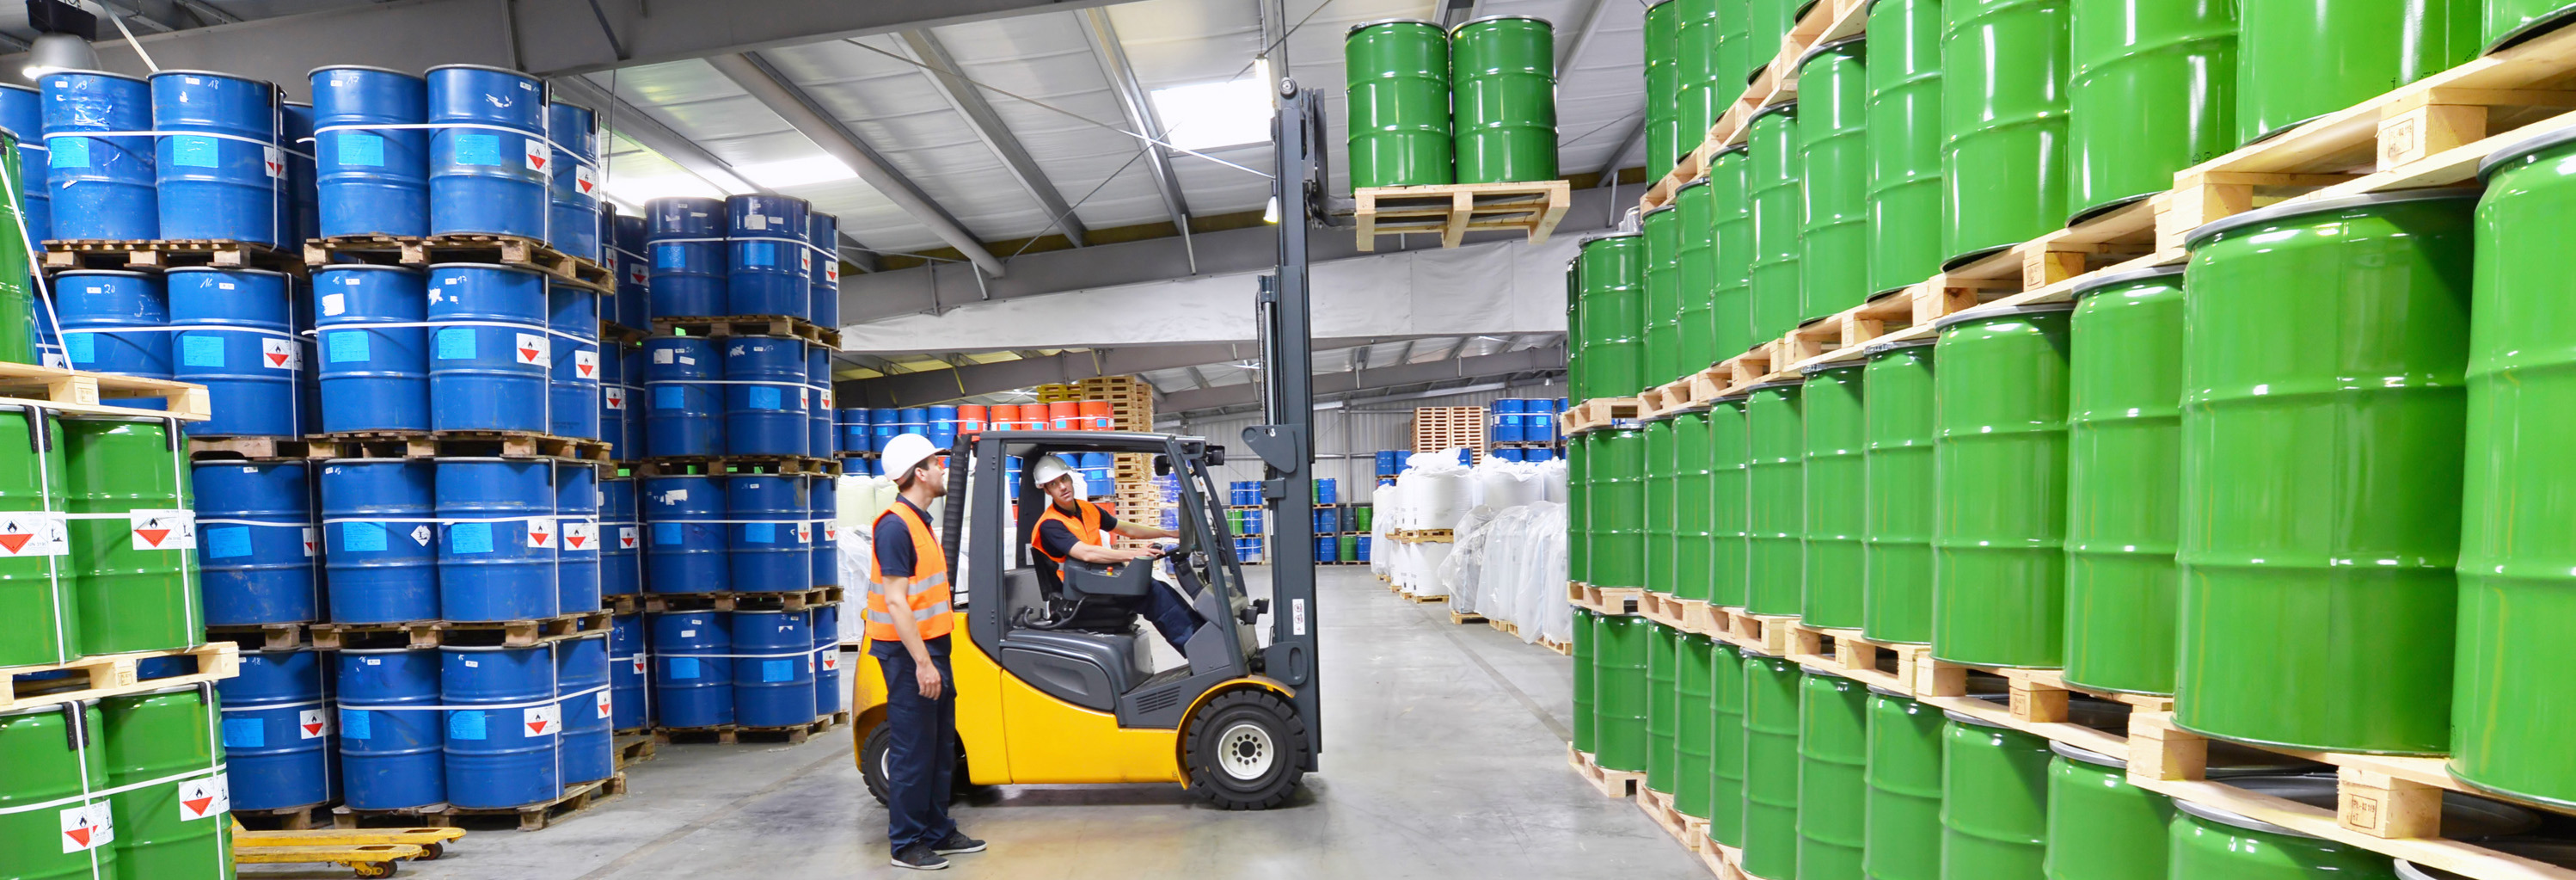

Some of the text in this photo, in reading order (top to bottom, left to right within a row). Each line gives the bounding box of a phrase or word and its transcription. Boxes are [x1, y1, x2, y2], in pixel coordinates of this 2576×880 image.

[75, 80, 88, 90] 19
[207, 79, 219, 89] 18
[103, 284, 116, 294] 20
